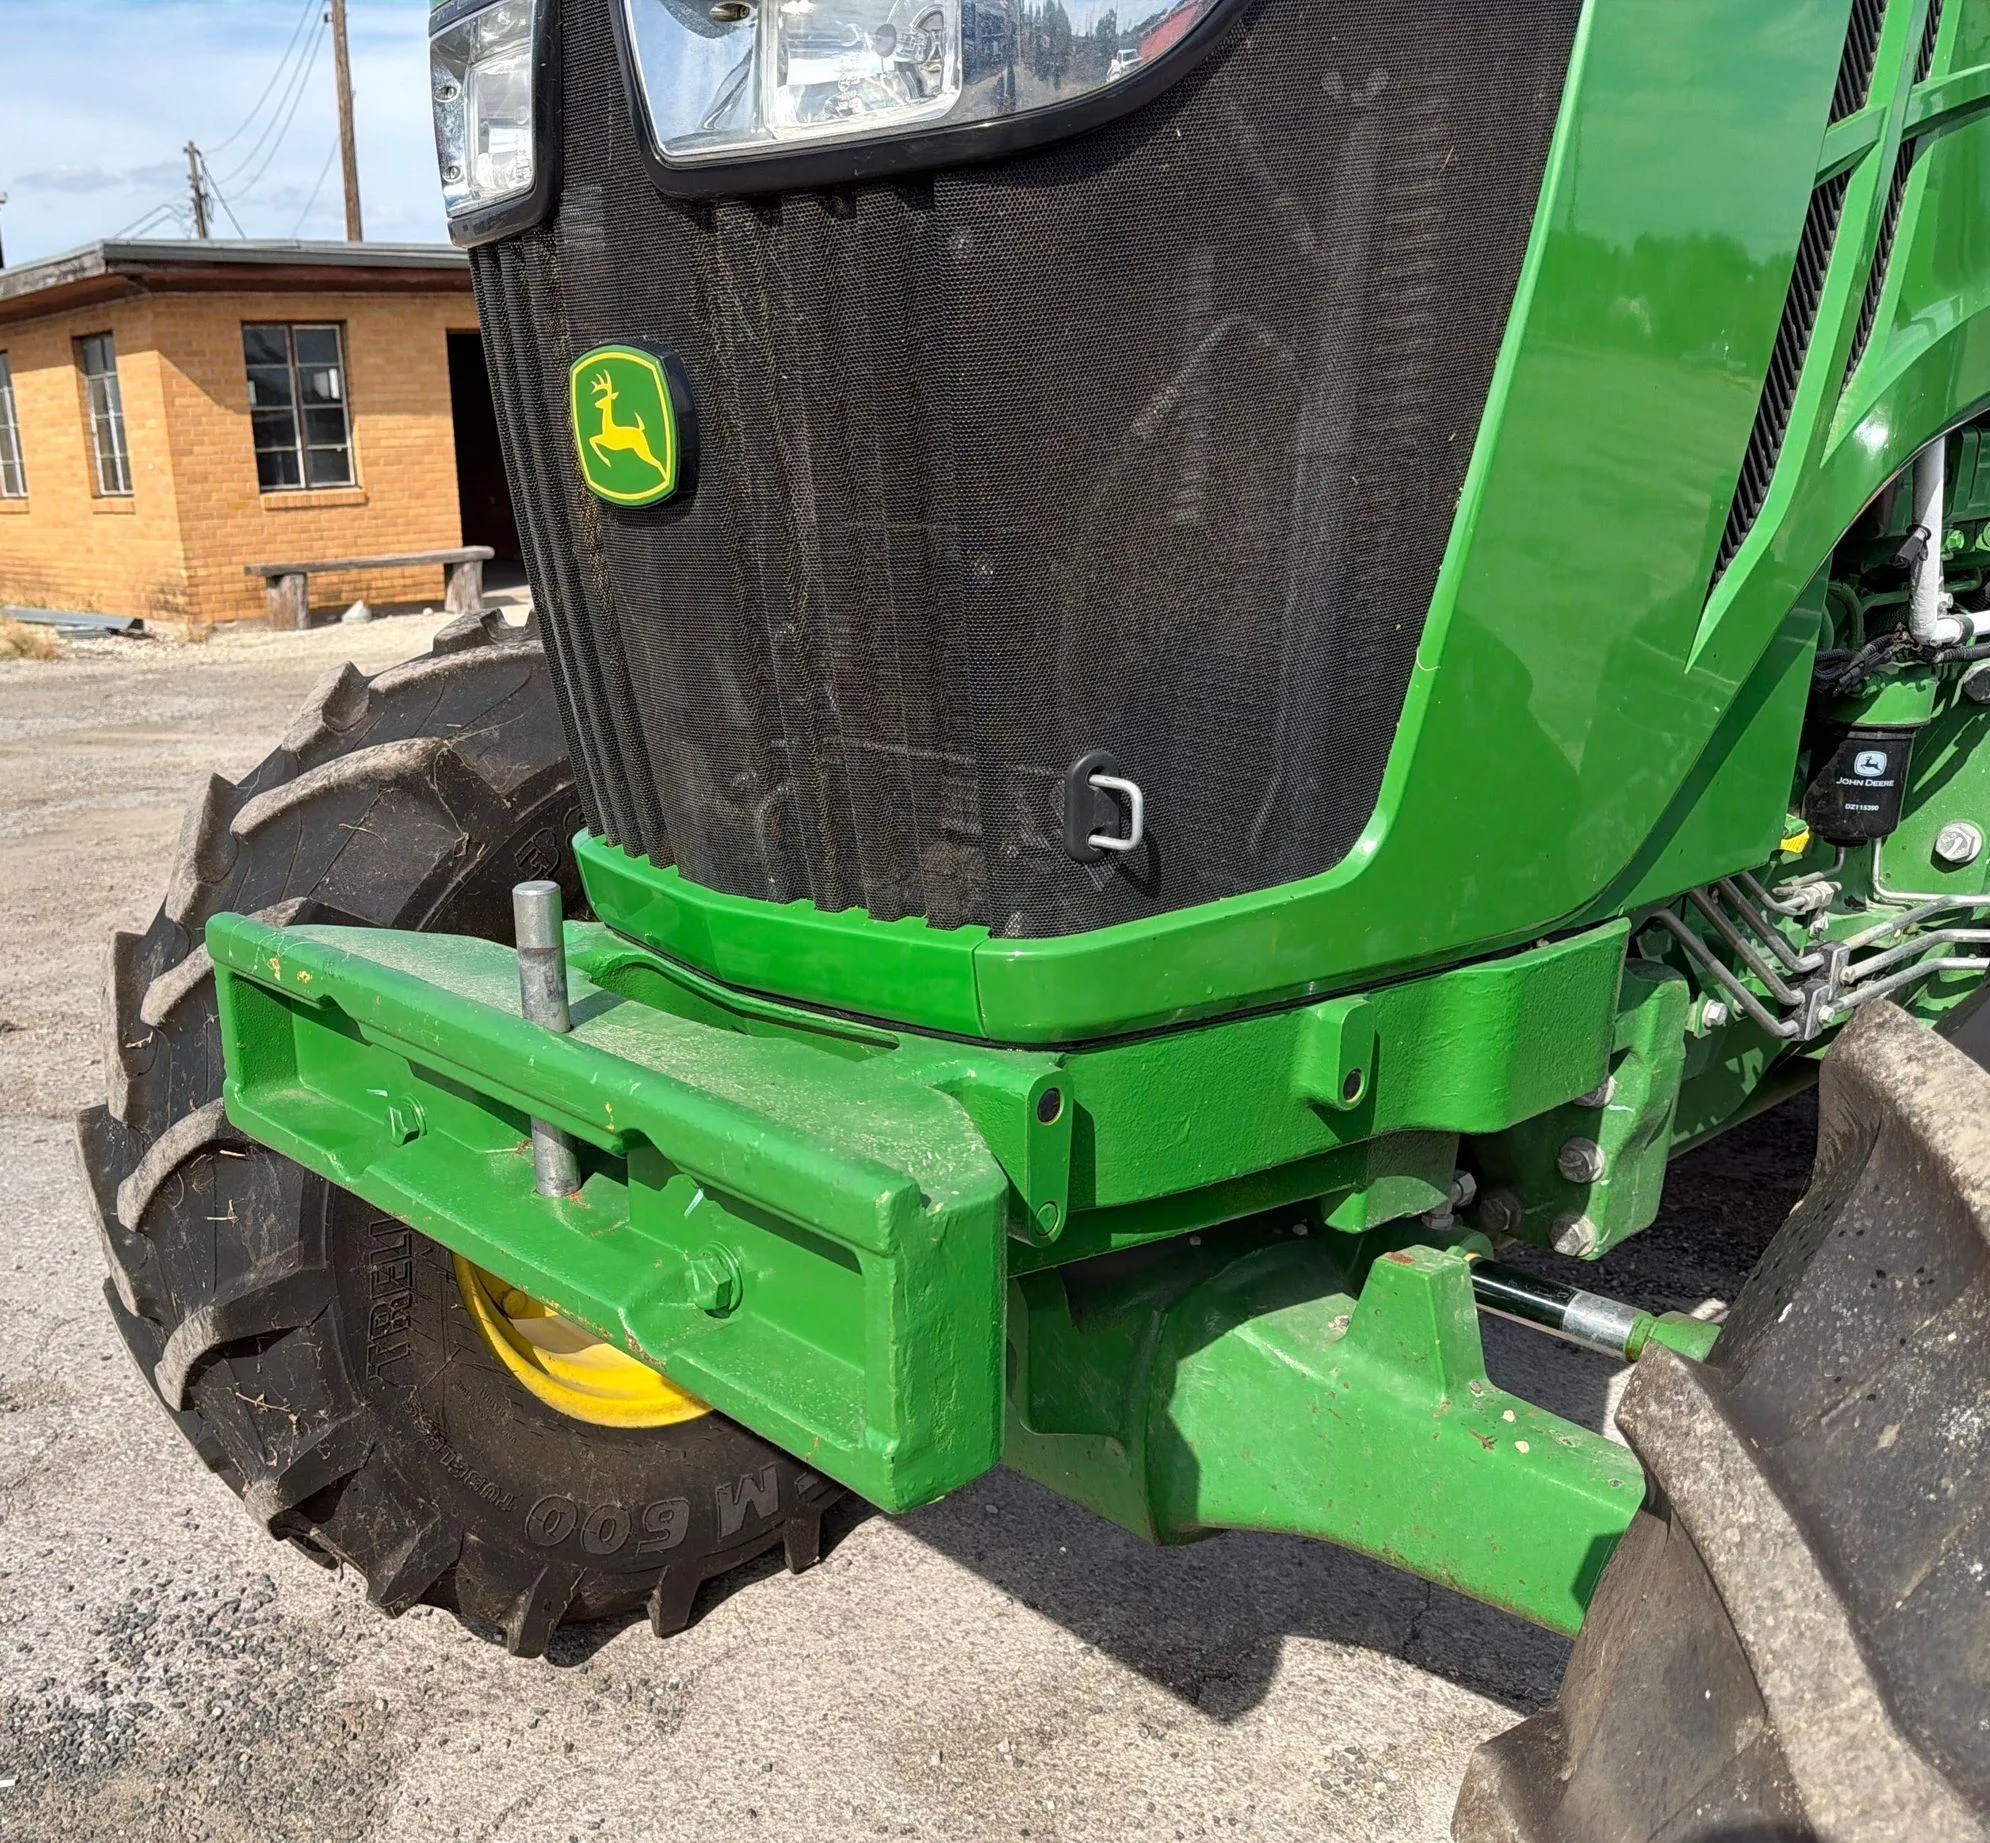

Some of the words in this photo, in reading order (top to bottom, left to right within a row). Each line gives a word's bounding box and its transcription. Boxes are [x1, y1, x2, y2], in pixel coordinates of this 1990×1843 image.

[1835, 776, 1864, 787] JOHN
[1865, 778, 1895, 787] DEERE
[524, 1493, 691, 1558] 600
